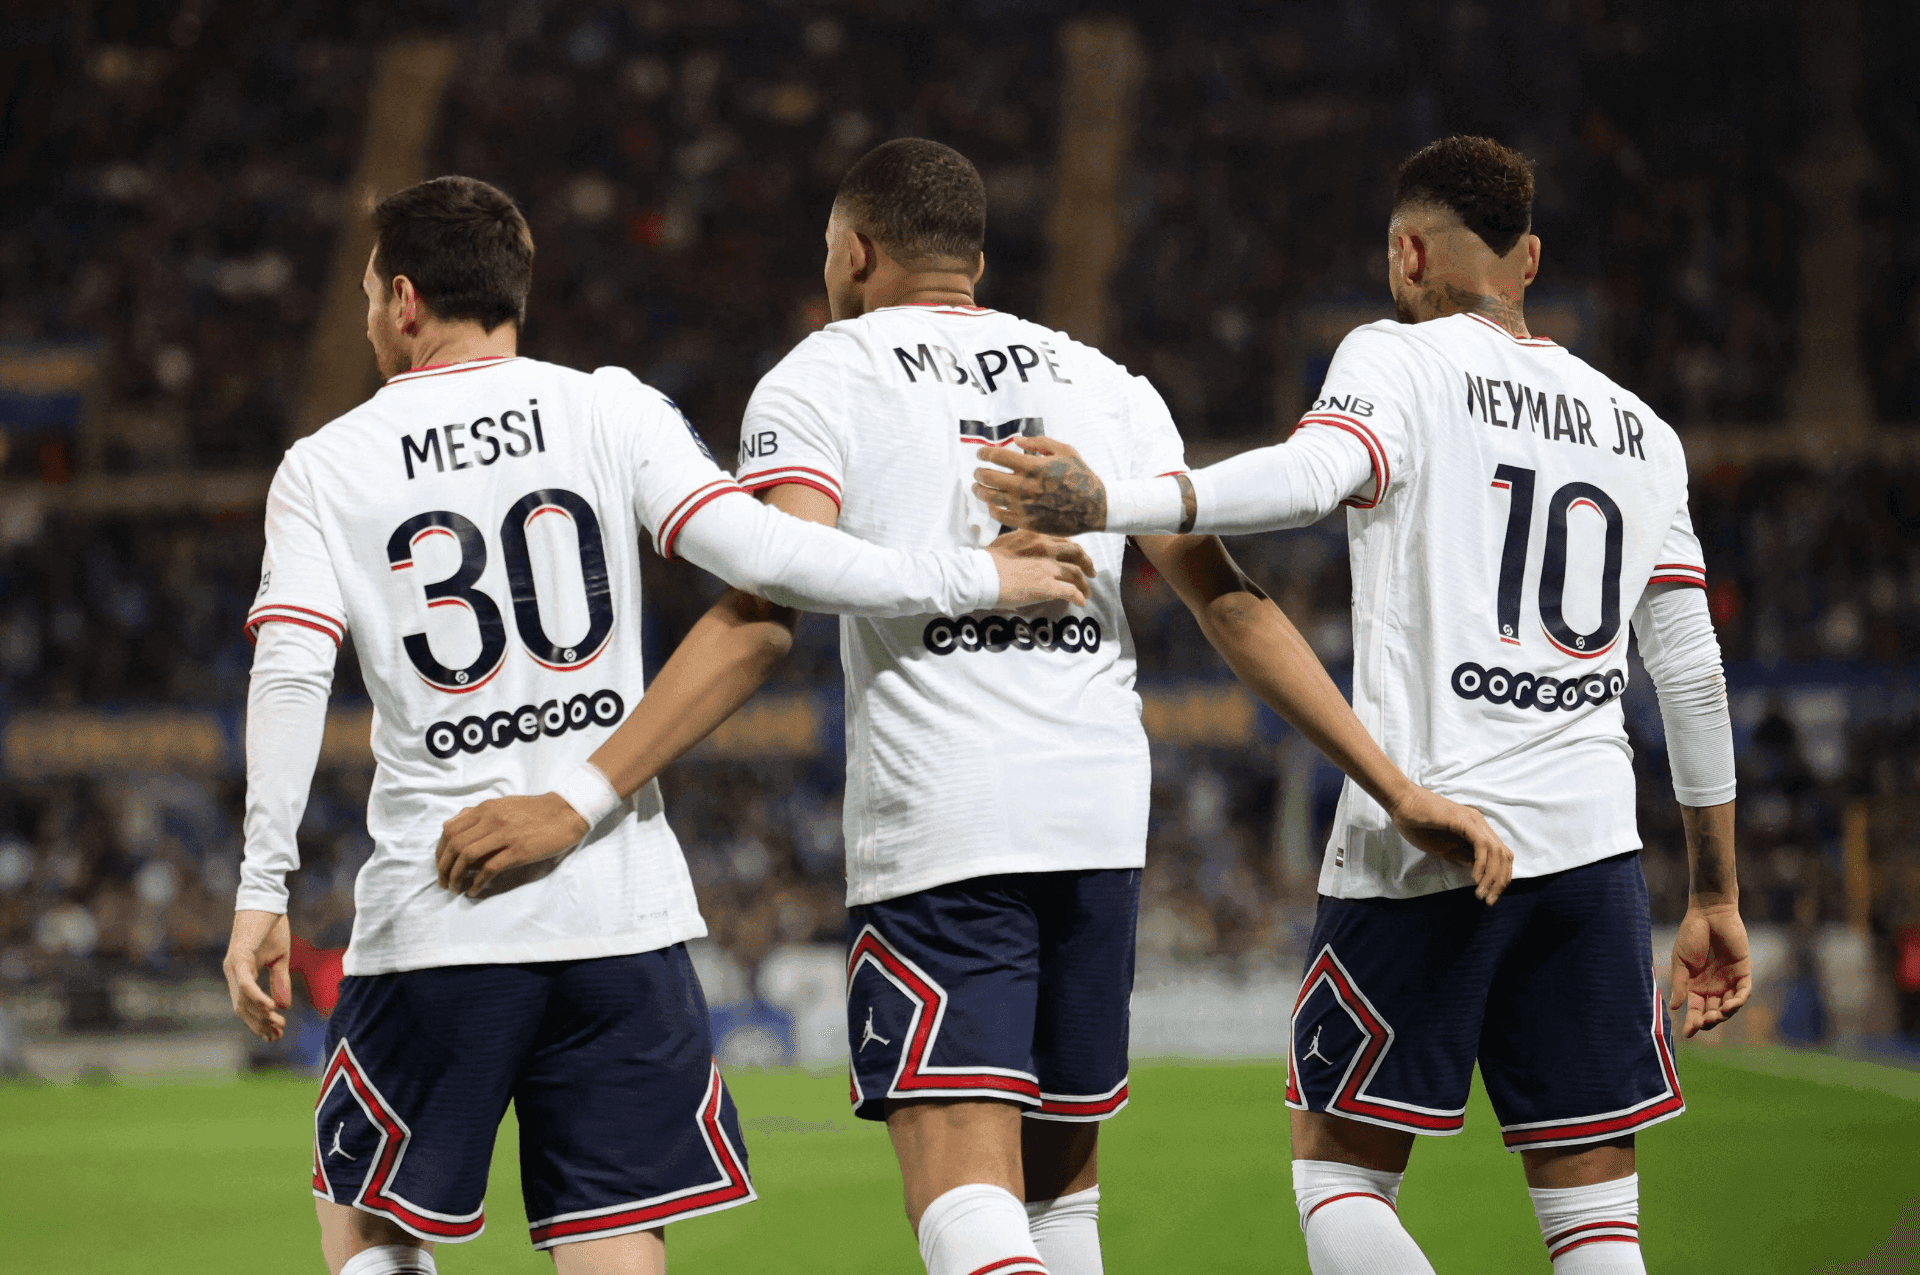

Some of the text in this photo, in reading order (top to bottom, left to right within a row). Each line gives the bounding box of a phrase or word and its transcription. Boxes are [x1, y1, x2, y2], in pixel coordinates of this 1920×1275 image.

[1465, 371, 1598, 448] NEYMAR
[739, 431, 778, 466] NB
[387, 488, 614, 693] 30
[1491, 464, 1623, 659] 10
[927, 619, 1100, 653] ooredoo
[428, 692, 621, 756] ooredoo
